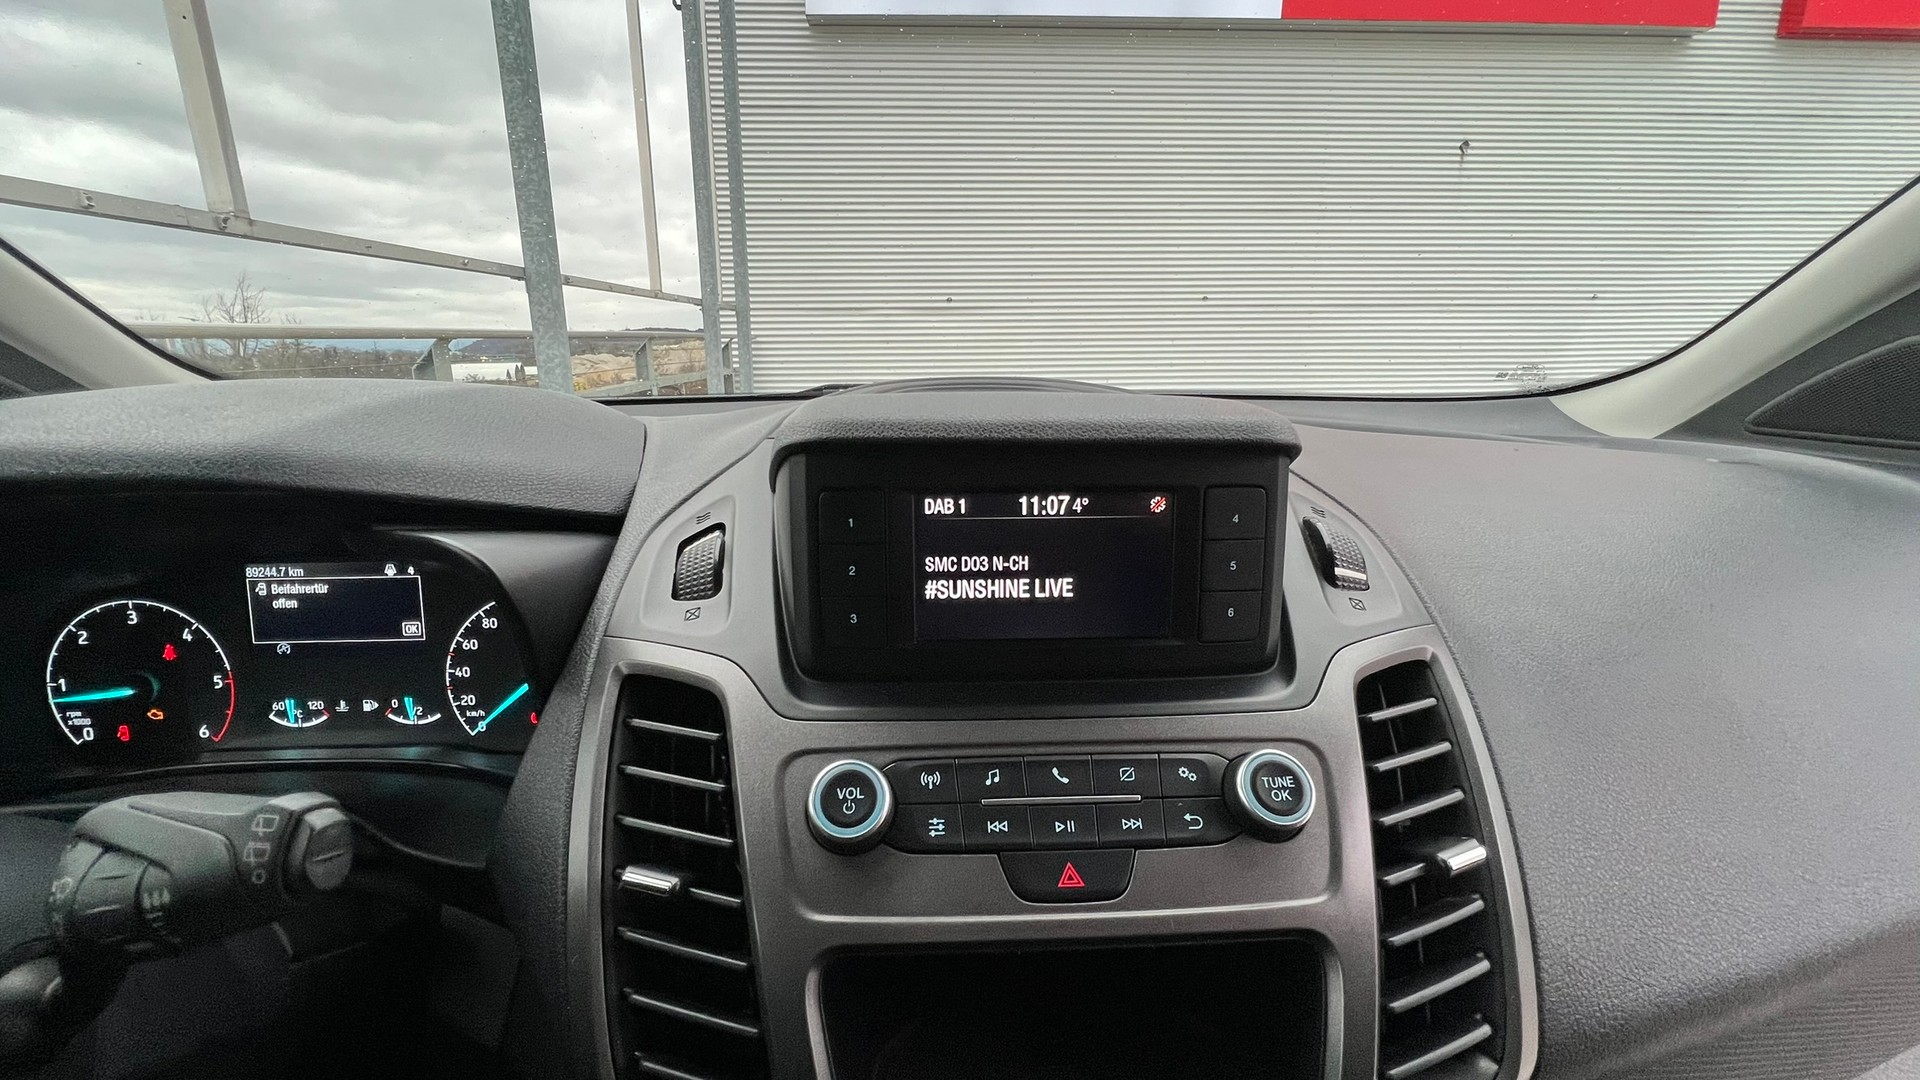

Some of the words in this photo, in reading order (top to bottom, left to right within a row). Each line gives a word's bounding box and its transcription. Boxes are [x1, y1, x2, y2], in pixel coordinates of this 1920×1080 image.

[924, 498, 954, 515] DAB
[958, 499, 966, 514] 1
[1019, 496, 1070, 515] 11:07
[848, 518, 854, 528] 1
[1232, 514, 1240, 524] 4
[925, 557, 957, 573] SMC
[993, 555, 1029, 571] N-CH
[1230, 561, 1237, 571] 5
[246, 567, 286, 578] 89244.7
[288, 567, 304, 577] km
[407, 566, 415, 575] 4
[848, 566, 856, 576] 2
[271, 583, 329, 595] Beifahrertür
[925, 579, 1030, 600] #SUNSHINE
[1035, 578, 1074, 598] LIVE
[272, 598, 298, 609] offen
[127, 611, 137, 624] 3
[1227, 608, 1235, 617] 6
[482, 618, 498, 629] 80
[850, 614, 858, 624] 3
[405, 624, 418, 634] OK
[77, 631, 89, 645] 2
[182, 629, 193, 641] 4
[462, 639, 479, 650] 60
[454, 666, 471, 678] 40
[58, 679, 66, 691] 1
[213, 675, 223, 689] 5
[272, 701, 285, 711] 60
[307, 701, 324, 710] 120
[391, 699, 399, 708] 0
[460, 695, 476, 706] 20
[466, 710, 486, 718] km/h
[199, 726, 209, 738] 6
[478, 721, 486, 732] 0
[83, 728, 94, 740] 0
[1261, 776, 1295, 788] TUNE
[836, 787, 864, 800] VOL
[1271, 789, 1292, 801] OK
